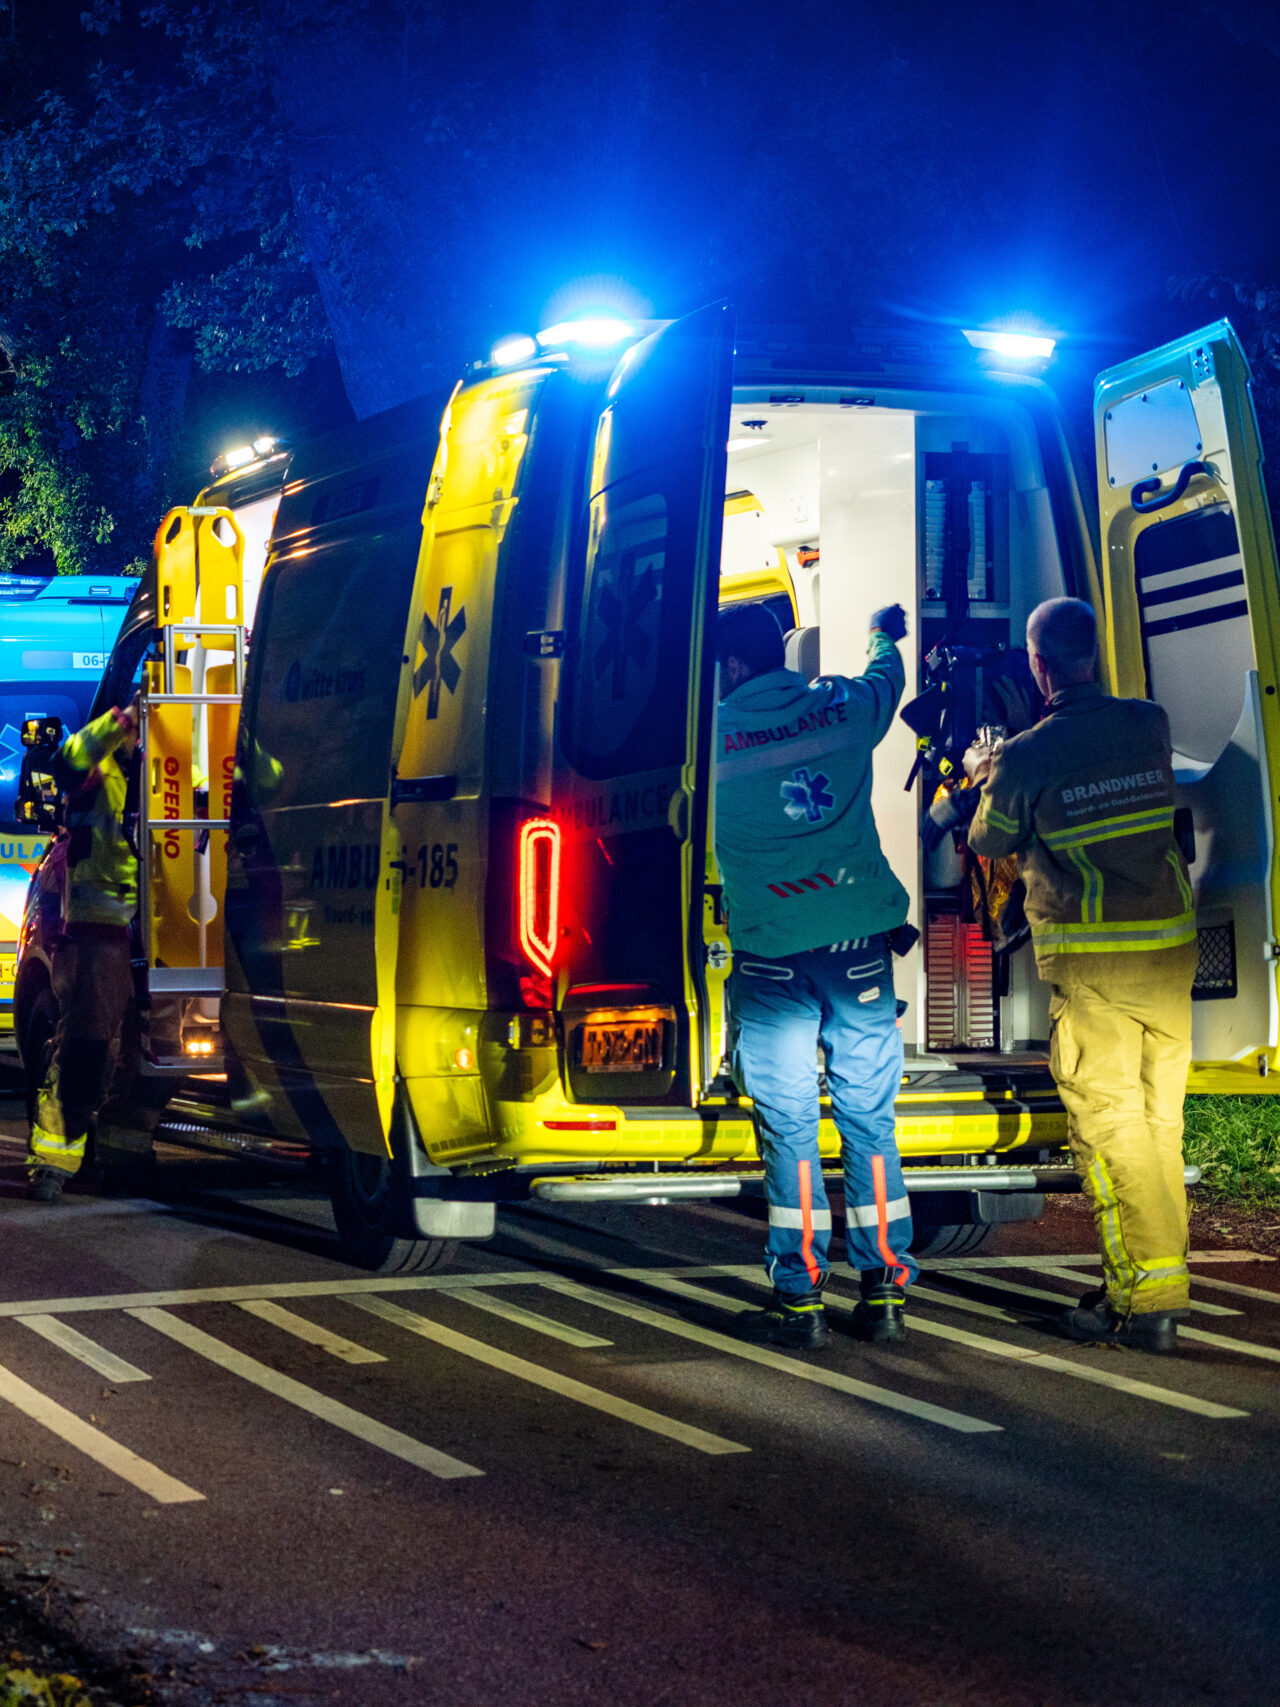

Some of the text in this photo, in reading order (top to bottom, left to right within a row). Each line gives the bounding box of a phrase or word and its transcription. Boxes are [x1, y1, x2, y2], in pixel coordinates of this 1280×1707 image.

[725, 703, 847, 754] AMBULANCE
[1061, 770, 1164, 803] BRANDWEER
[164, 779, 180, 859] FERNO
[311, 845, 380, 888] AMBU
